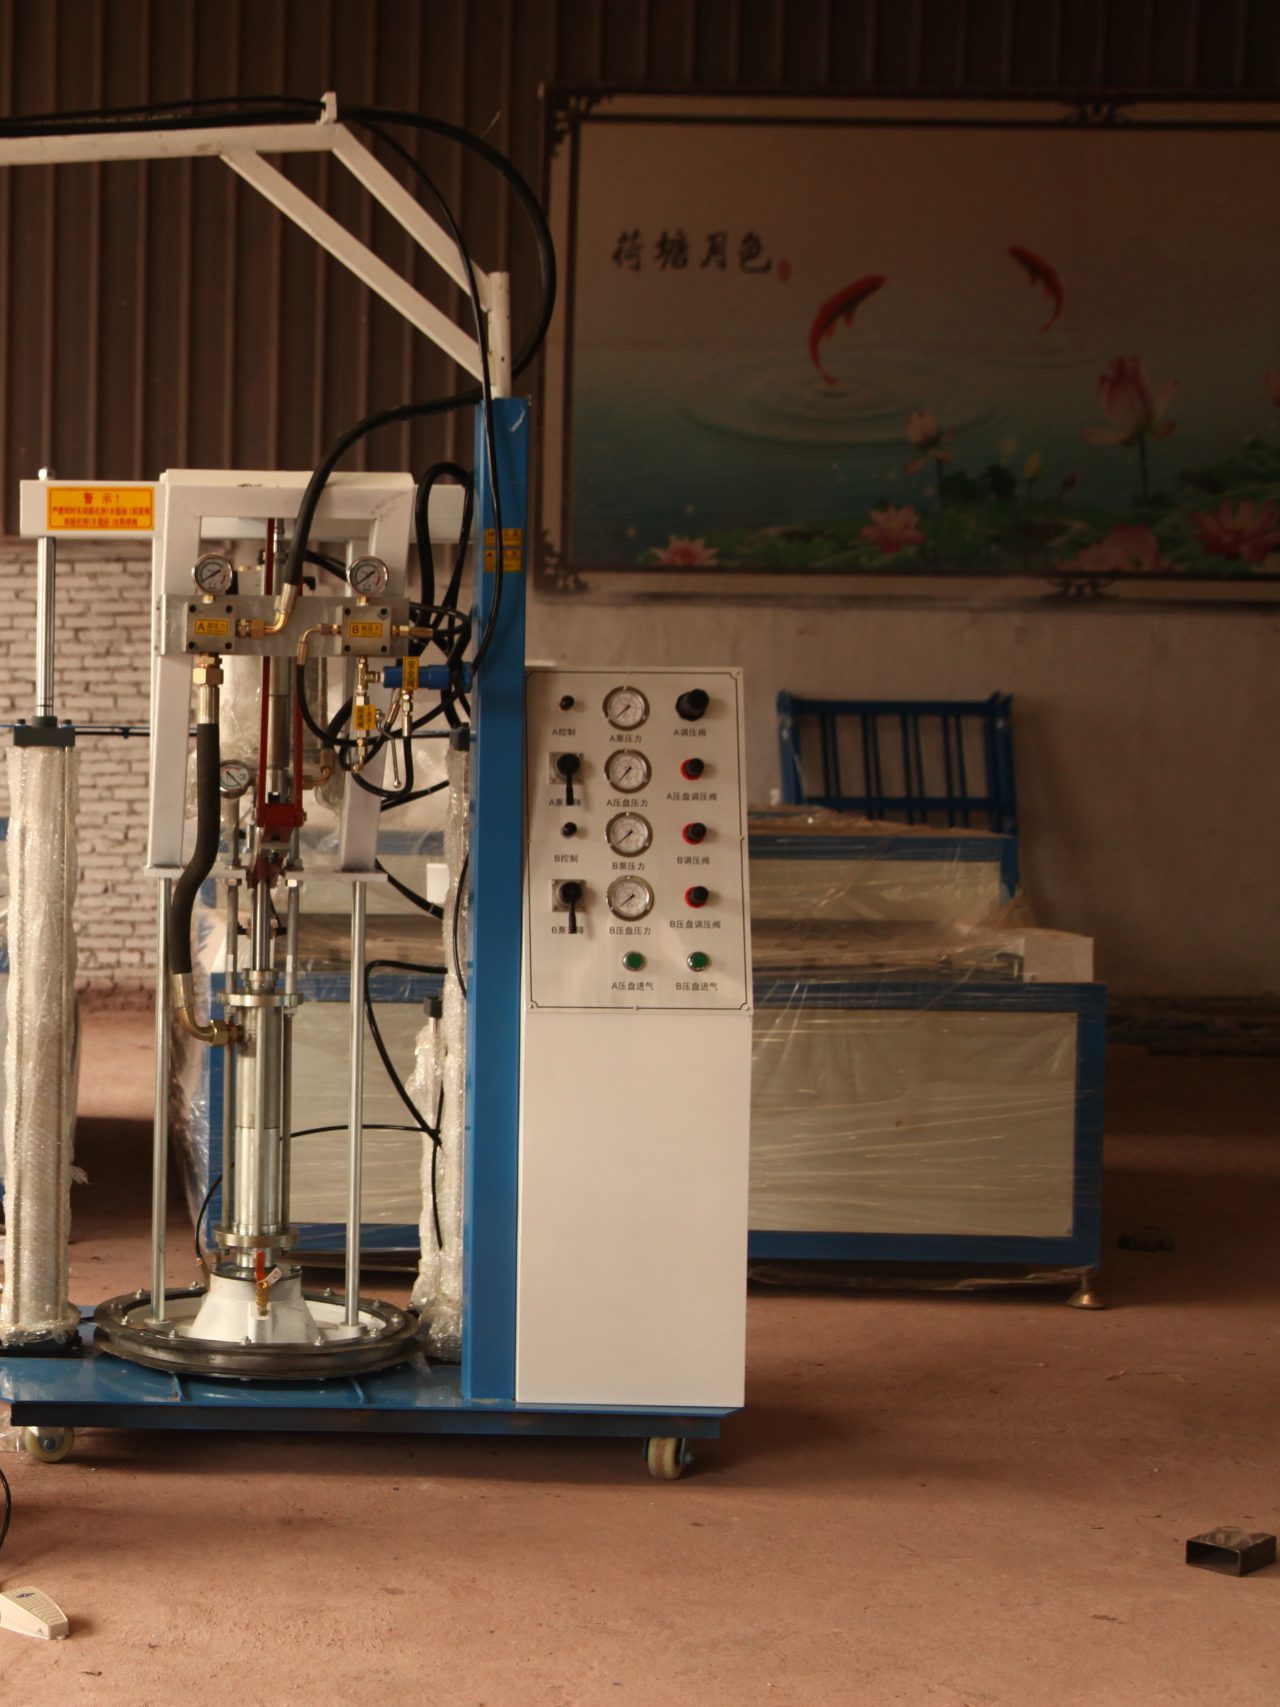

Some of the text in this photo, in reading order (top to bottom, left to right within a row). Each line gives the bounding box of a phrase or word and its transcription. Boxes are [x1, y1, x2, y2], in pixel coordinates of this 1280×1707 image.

[612, 228, 772, 274] 荷塘月色
[552, 728, 576, 737] A控制
[673, 728, 707, 737] A调压阀
[666, 792, 718, 801] A压盘调压阀
[606, 799, 648, 808] A压盘压力
[554, 854, 579, 863] B控制
[677, 856, 710, 865] B调压阀
[670, 920, 721, 929] B压盘调压阀
[609, 926, 651, 935] B压盘压力
[611, 982, 654, 991] A压盘进气
[676, 982, 719, 991] B压盘进气
